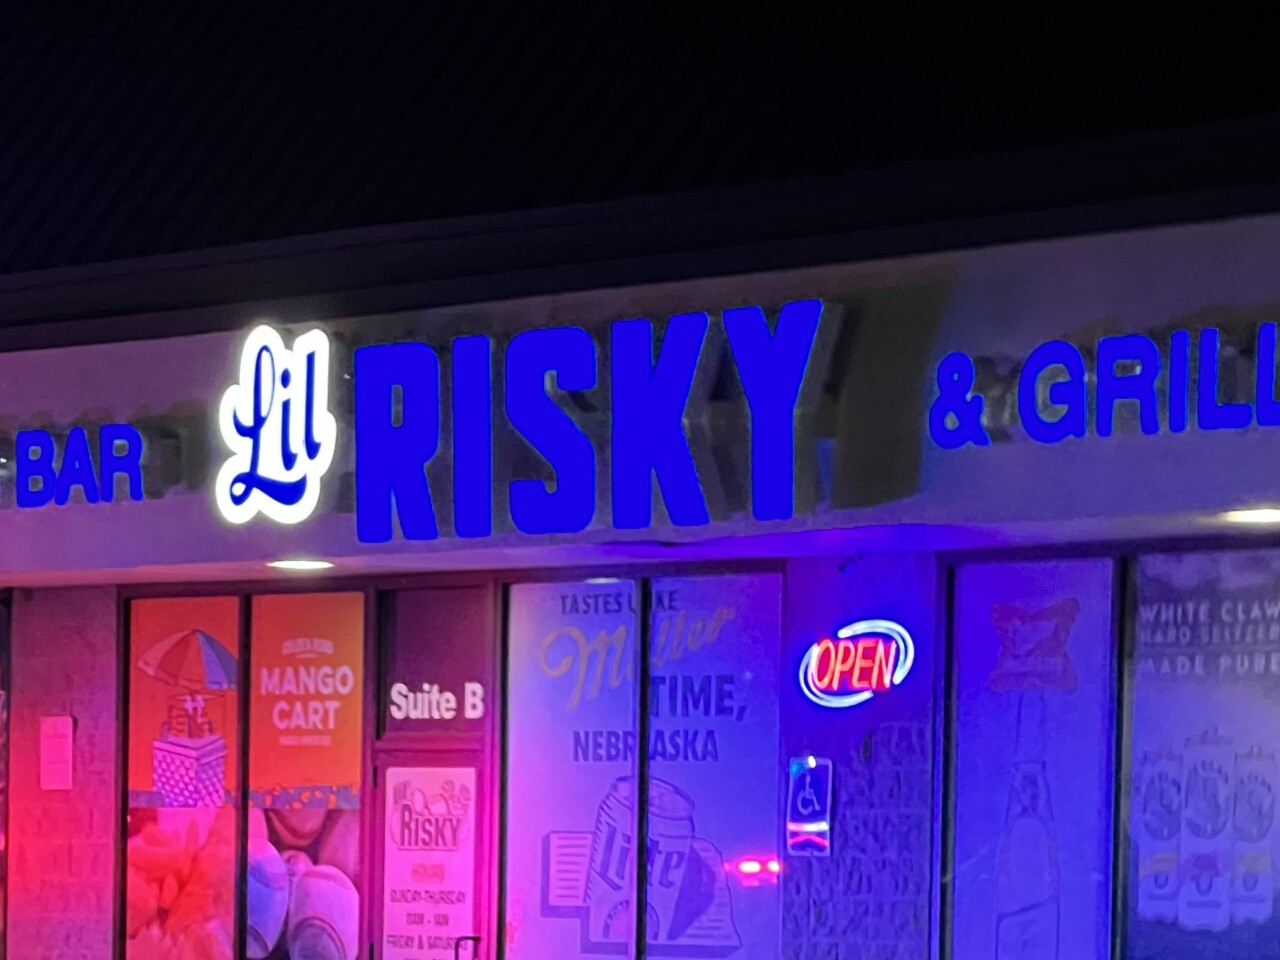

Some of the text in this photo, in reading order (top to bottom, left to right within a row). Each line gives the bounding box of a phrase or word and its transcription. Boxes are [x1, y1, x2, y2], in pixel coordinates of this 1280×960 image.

[225, 299, 823, 544] Lil RISKY
[927, 351, 992, 452] &
[15, 423, 144, 508] BAR
[560, 589, 678, 616] TASTES LKE
[1139, 598, 1280, 625] WHITE CLAW
[260, 665, 354, 696] MANGO
[540, 607, 736, 713] Mller
[813, 638, 897, 691] OPEN
[272, 700, 342, 731] CART
[389, 682, 485, 720] Suite B
[400, 802, 461, 848] RISKY
